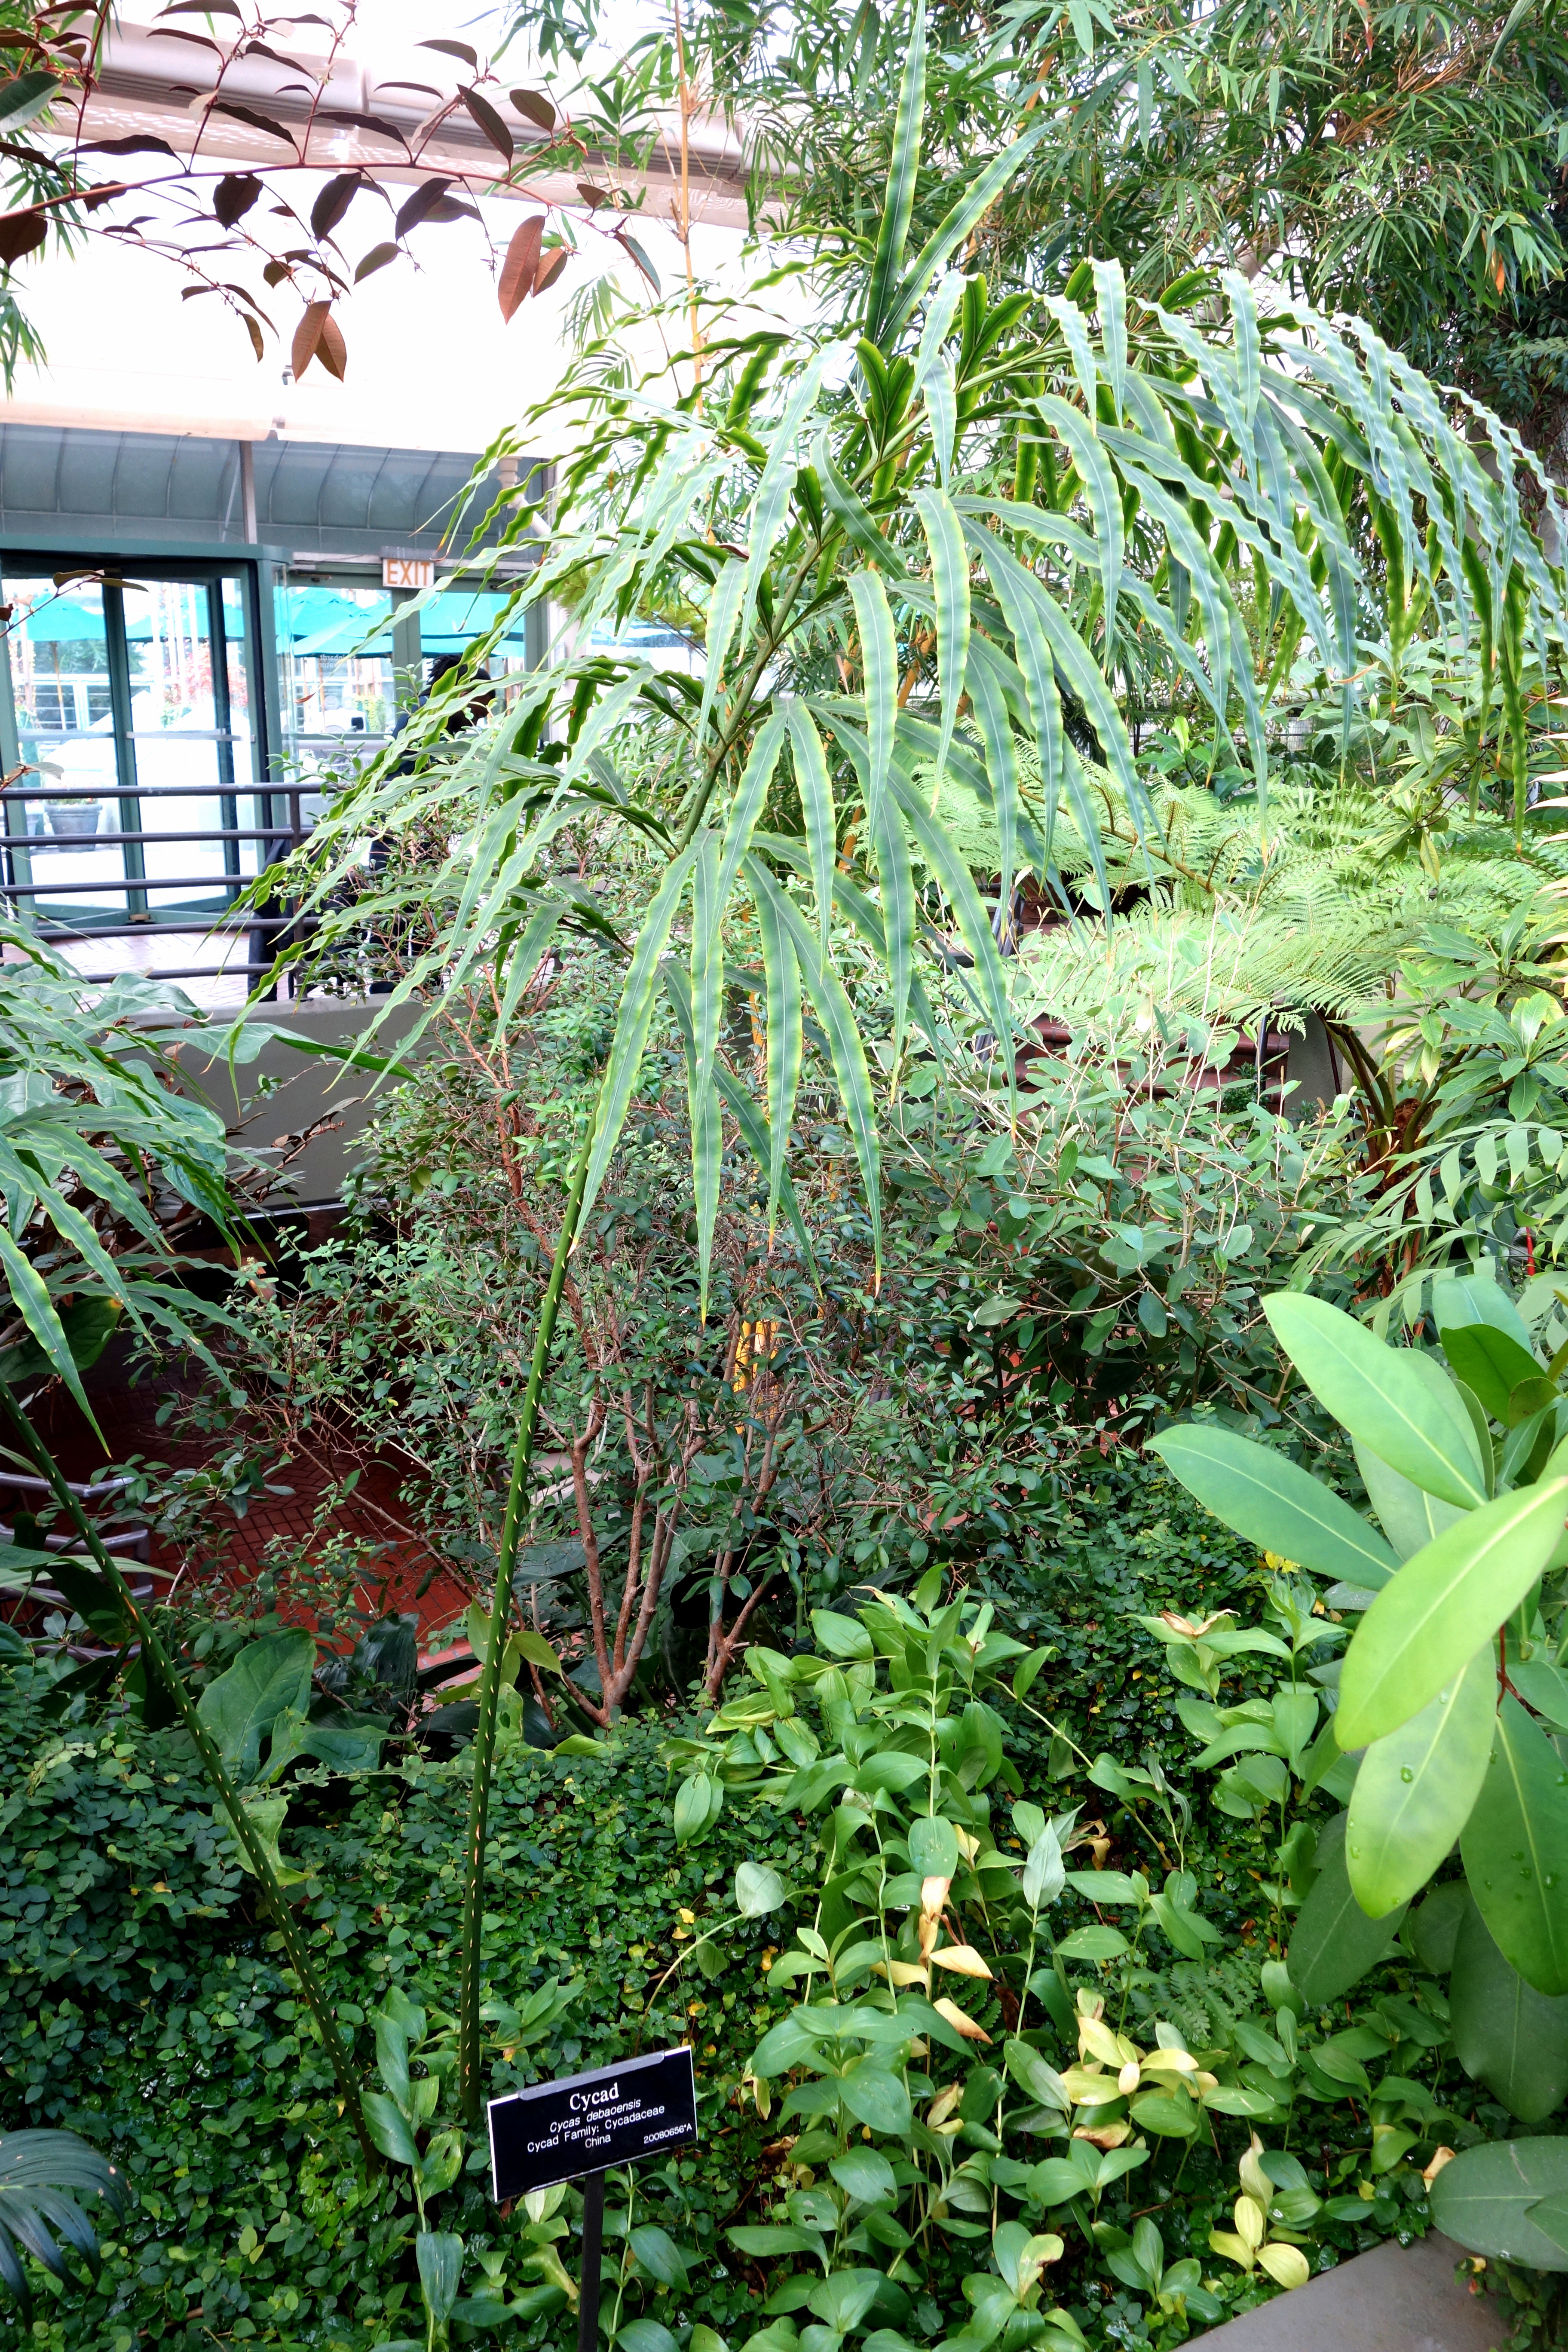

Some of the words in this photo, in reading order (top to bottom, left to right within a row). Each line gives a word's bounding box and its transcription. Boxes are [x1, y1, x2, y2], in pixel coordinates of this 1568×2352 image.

[387, 559, 430, 586] EXIT
[570, 2082, 619, 2111] Cycad
[527, 2137, 559, 2153] Cycad
[564, 2125, 599, 2144] Family:
[605, 2105, 665, 2130] Cycadaceae
[550, 2117, 581, 2133] Cycas
[586, 2099, 641, 2122] debaoensis
[585, 2134, 611, 2148] China
